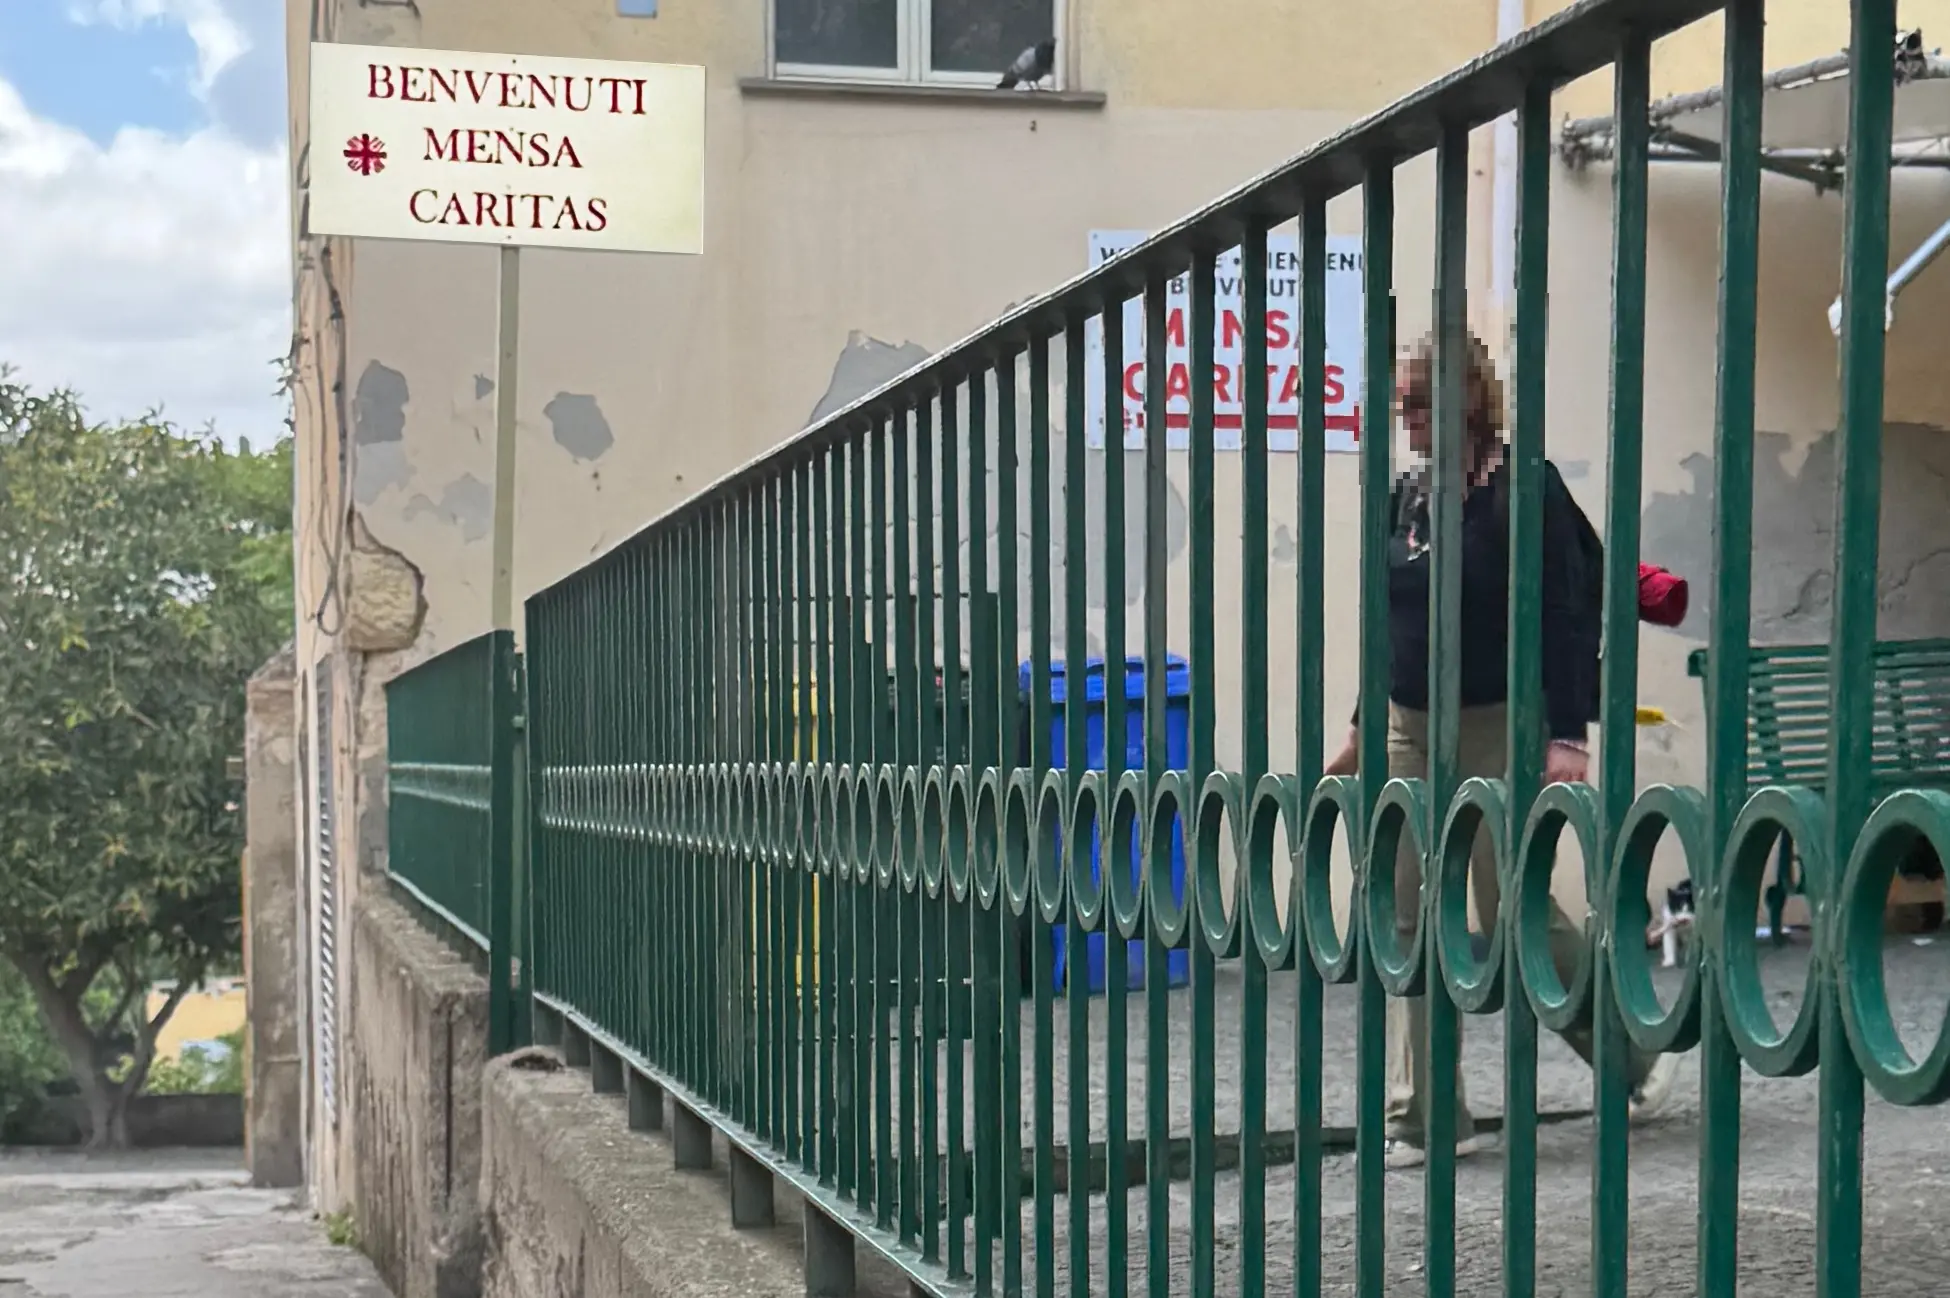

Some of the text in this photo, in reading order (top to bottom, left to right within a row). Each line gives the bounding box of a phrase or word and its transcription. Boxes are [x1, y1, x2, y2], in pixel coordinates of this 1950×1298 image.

[368, 64, 647, 115] BENVENUTI
[423, 127, 583, 168] MENSA
[409, 188, 607, 231] CARITAS
